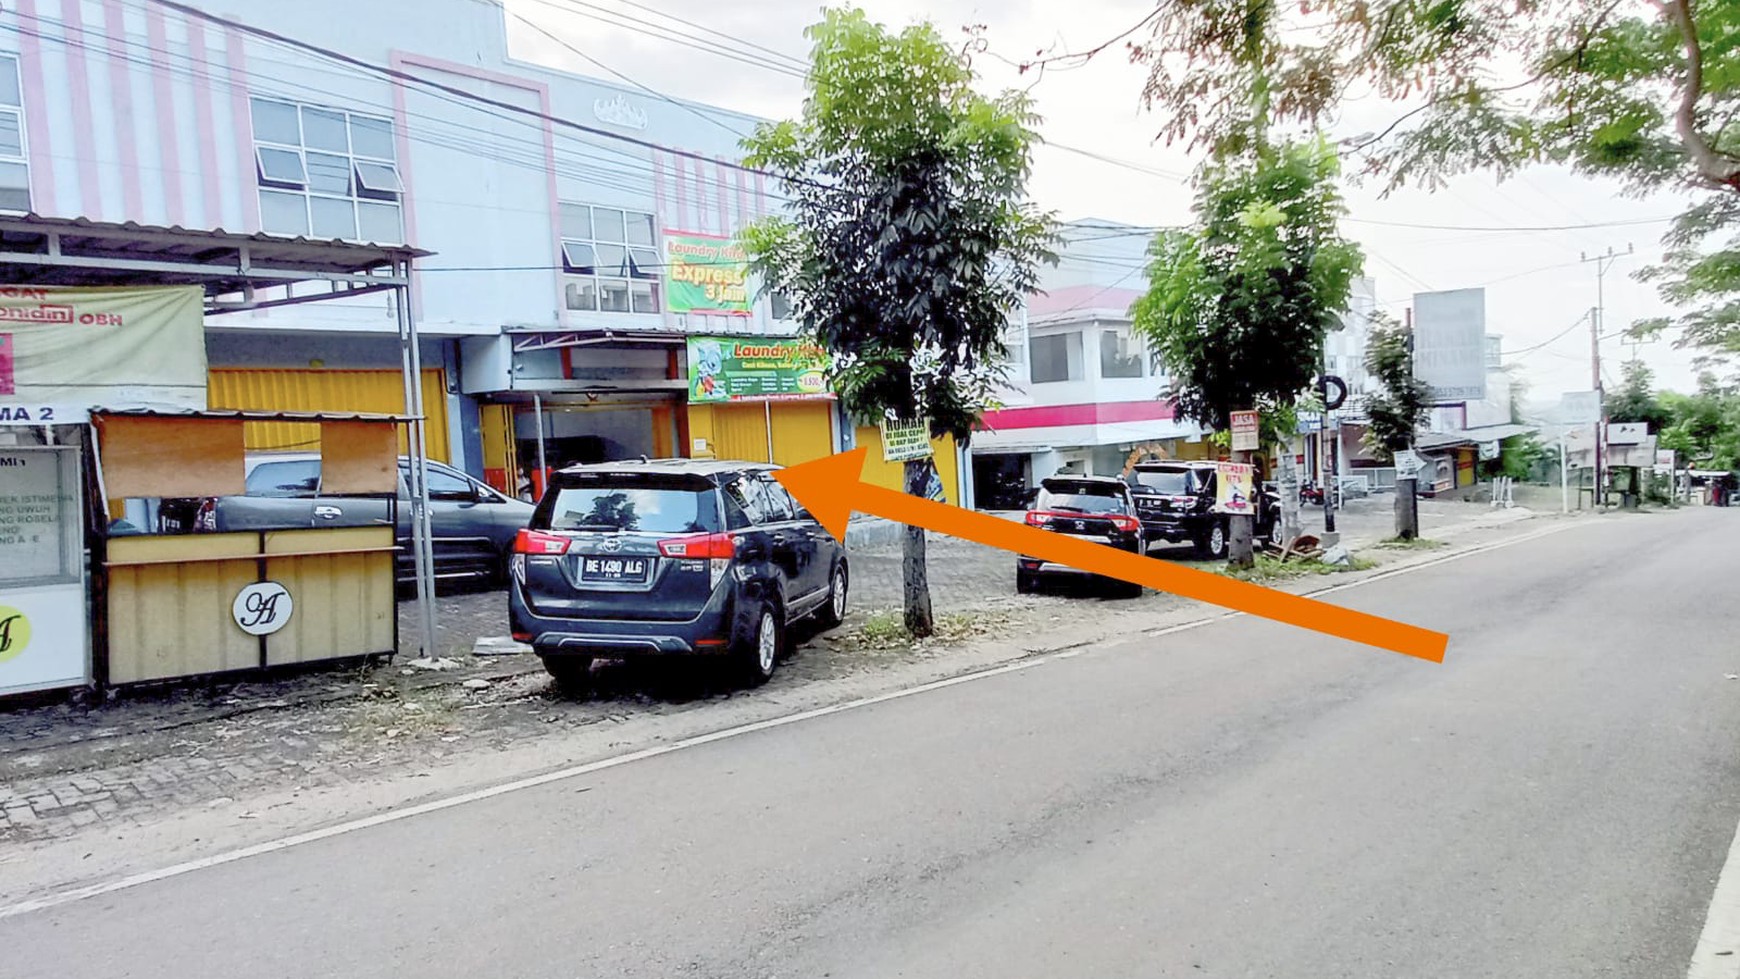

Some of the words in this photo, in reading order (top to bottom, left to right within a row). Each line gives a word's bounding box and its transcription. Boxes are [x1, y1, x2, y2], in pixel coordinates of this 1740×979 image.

[668, 241, 718, 260] Laundry
[672, 259, 744, 287] Express
[705, 281, 716, 300] 3
[79, 313, 122, 326] OBH
[734, 342, 793, 362] Laundry
[40, 407, 54, 420] 2
[17, 505, 51, 514] UWUH
[586, 559, 599, 572] BE
[625, 560, 643, 573] ALG
[240, 592, 286, 626] A
